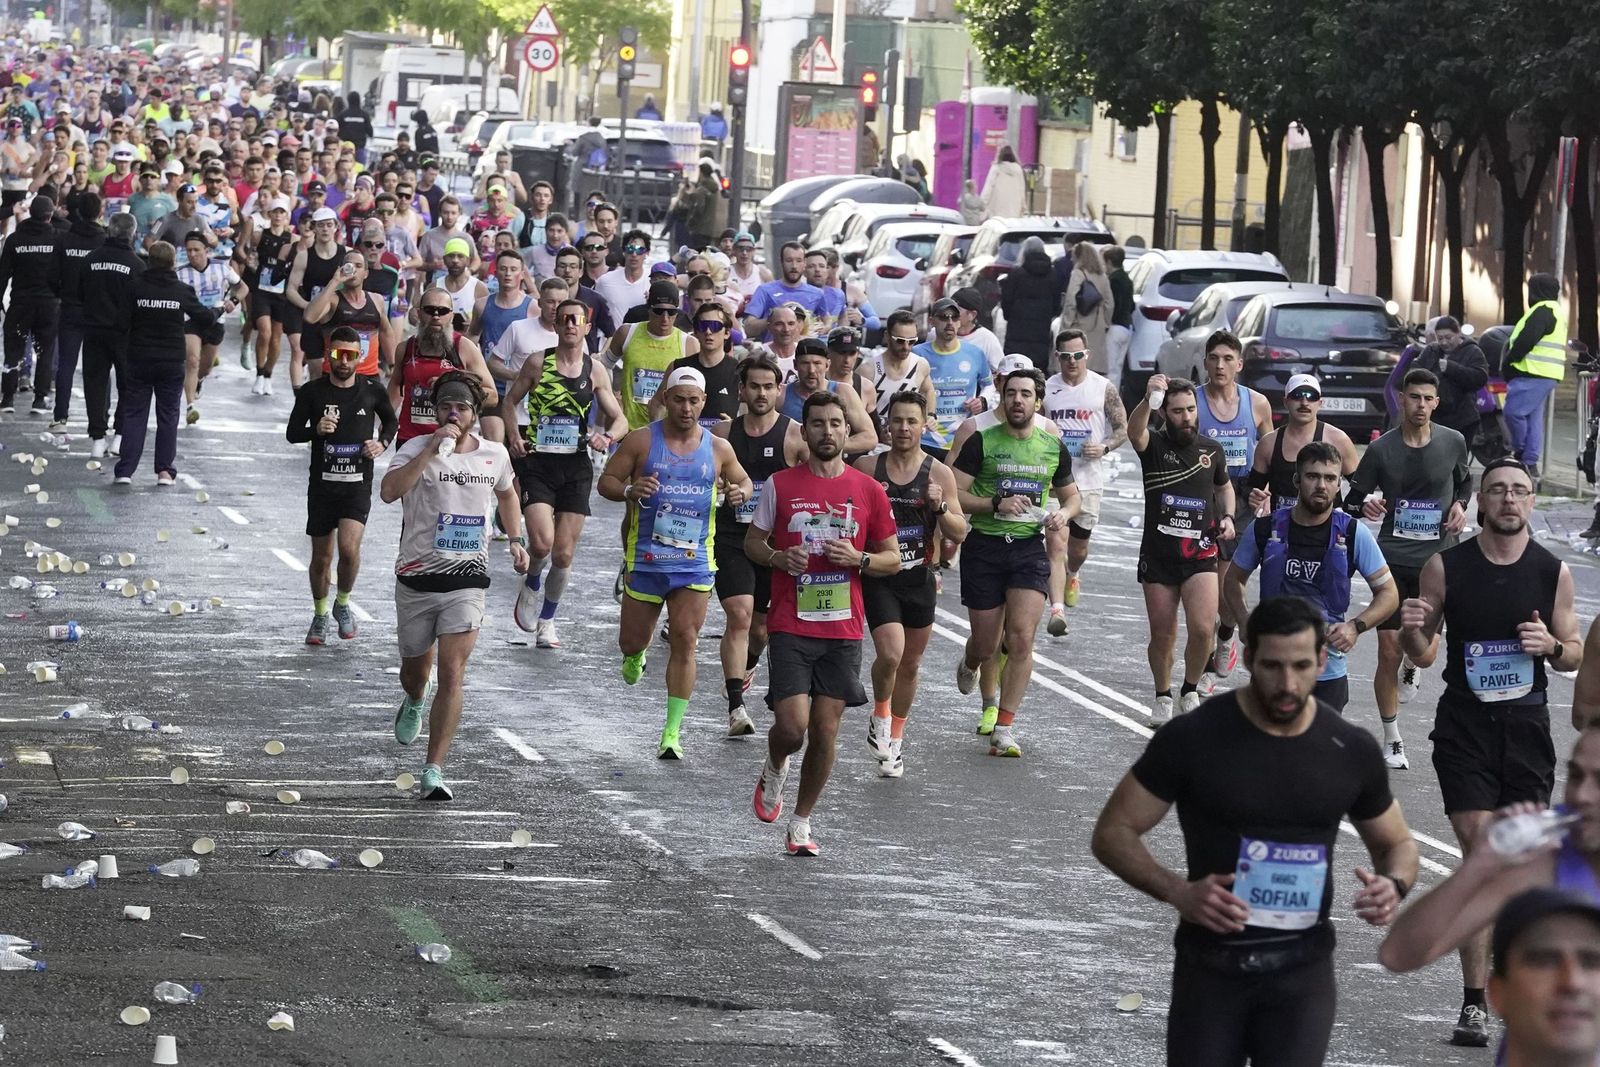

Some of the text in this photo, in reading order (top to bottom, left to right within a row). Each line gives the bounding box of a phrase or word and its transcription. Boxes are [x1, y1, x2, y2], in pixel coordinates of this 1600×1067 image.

[531, 48, 552, 60] 30
[90, 262, 131, 275] VOLUNTEER
[136, 299, 181, 309] VOLUNTEER
[1342, 400, 1362, 410] GBR
[1050, 409, 1093, 420] MRW
[544, 436, 570, 445] FRANK
[330, 465, 357, 473] ALLAN
[996, 464, 1018, 473] MEDIO
[1013, 481, 1039, 489] ZURICH
[455, 517, 481, 525] ZURICH
[672, 519, 687, 528] 9729
[1169, 517, 1192, 529] SUSO
[1394, 520, 1440, 531] ALEJANDRO
[896, 528, 919, 537] URICH
[437, 538, 480, 550] @LEIVA95
[898, 542, 909, 550] 23
[1285, 558, 1321, 581] CV
[815, 574, 845, 582] ZURICH
[816, 599, 835, 610] J.E.
[1489, 662, 1511, 672] 8250
[1480, 672, 1522, 688] PAWEŁ
[1272, 847, 1319, 861] ZURICH
[1249, 887, 1310, 908] SOFIAN
